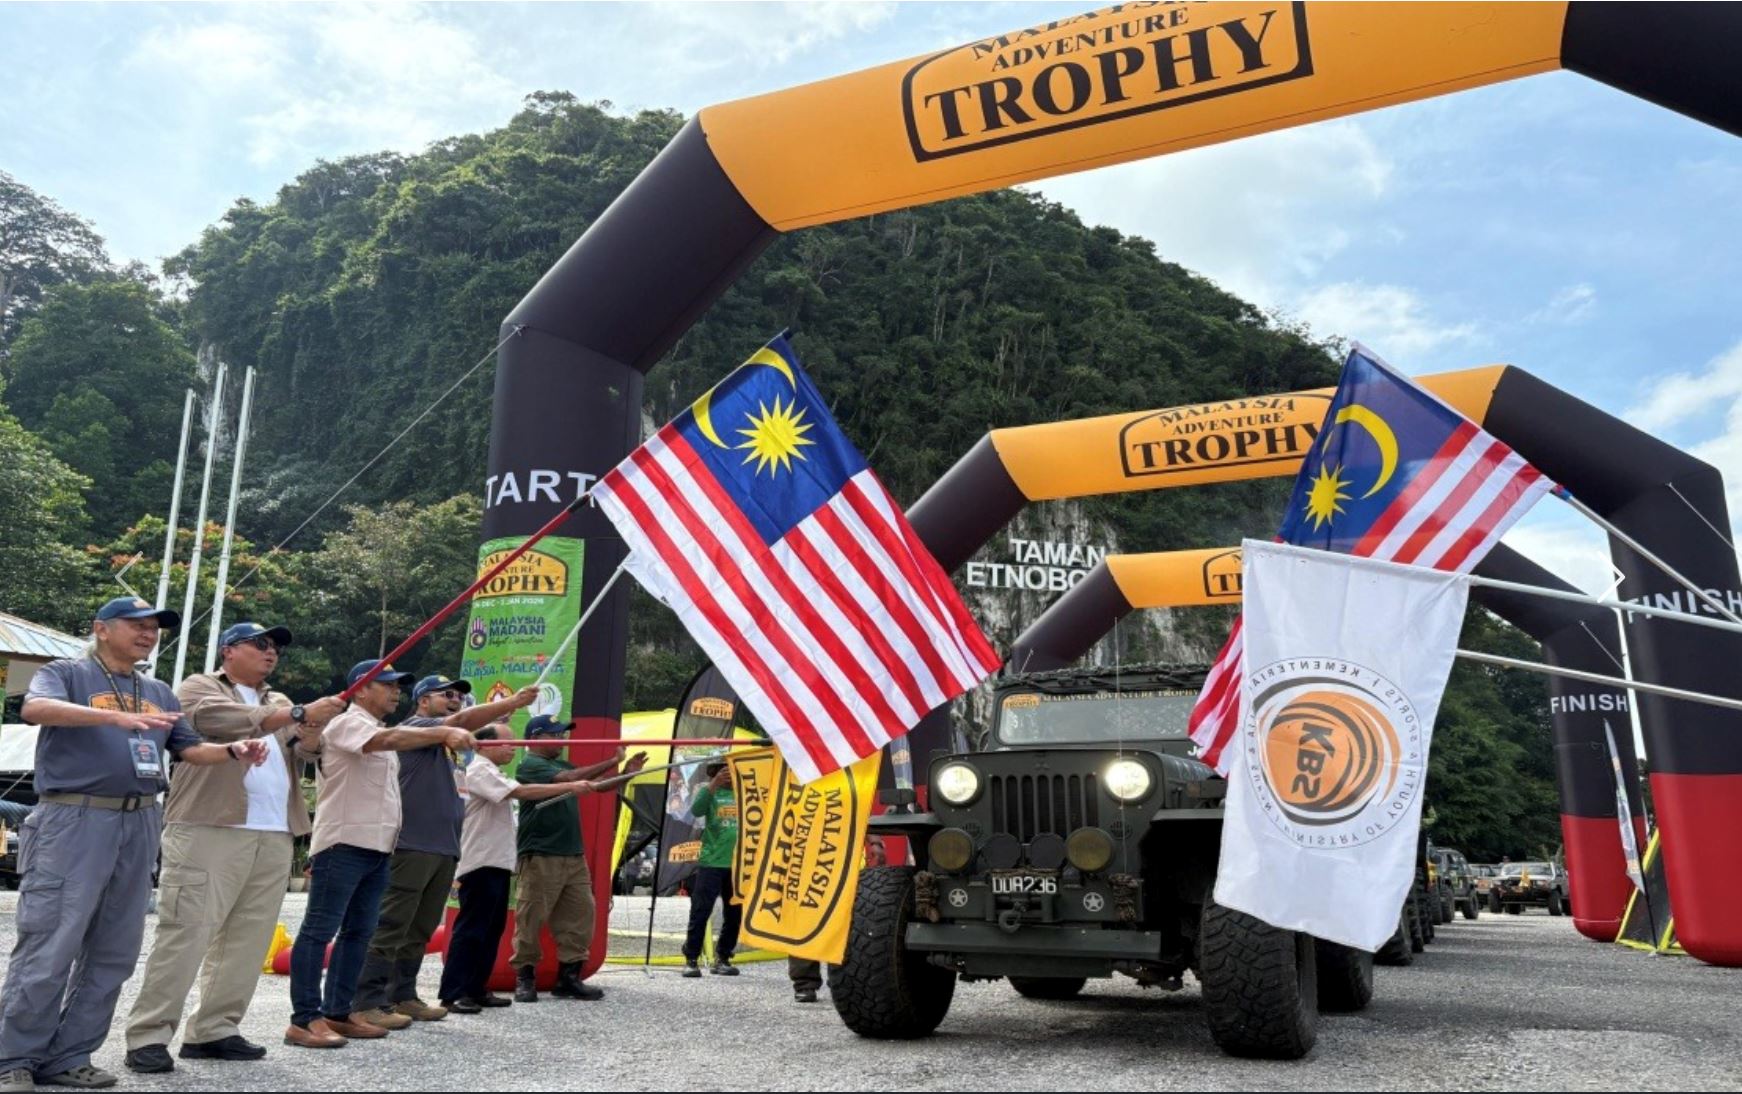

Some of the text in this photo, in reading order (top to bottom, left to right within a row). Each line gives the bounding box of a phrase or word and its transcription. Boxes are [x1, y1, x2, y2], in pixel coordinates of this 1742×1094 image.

[992, 6, 1189, 72] ADVENTURE
[924, 10, 1278, 142] TROPHY
[1159, 398, 1295, 427] MALAYSIA
[1172, 411, 1285, 436] ADVENTURE
[1009, 538, 1105, 568] TAMAN
[489, 616, 545, 626] MALAYSIA
[489, 624, 546, 636] MADANI
[1551, 693, 1629, 715] FINISH
[760, 782, 806, 924] ROPHY
[786, 786, 822, 902] ADVENTURE
[800, 787, 844, 910] MALAYSIA
